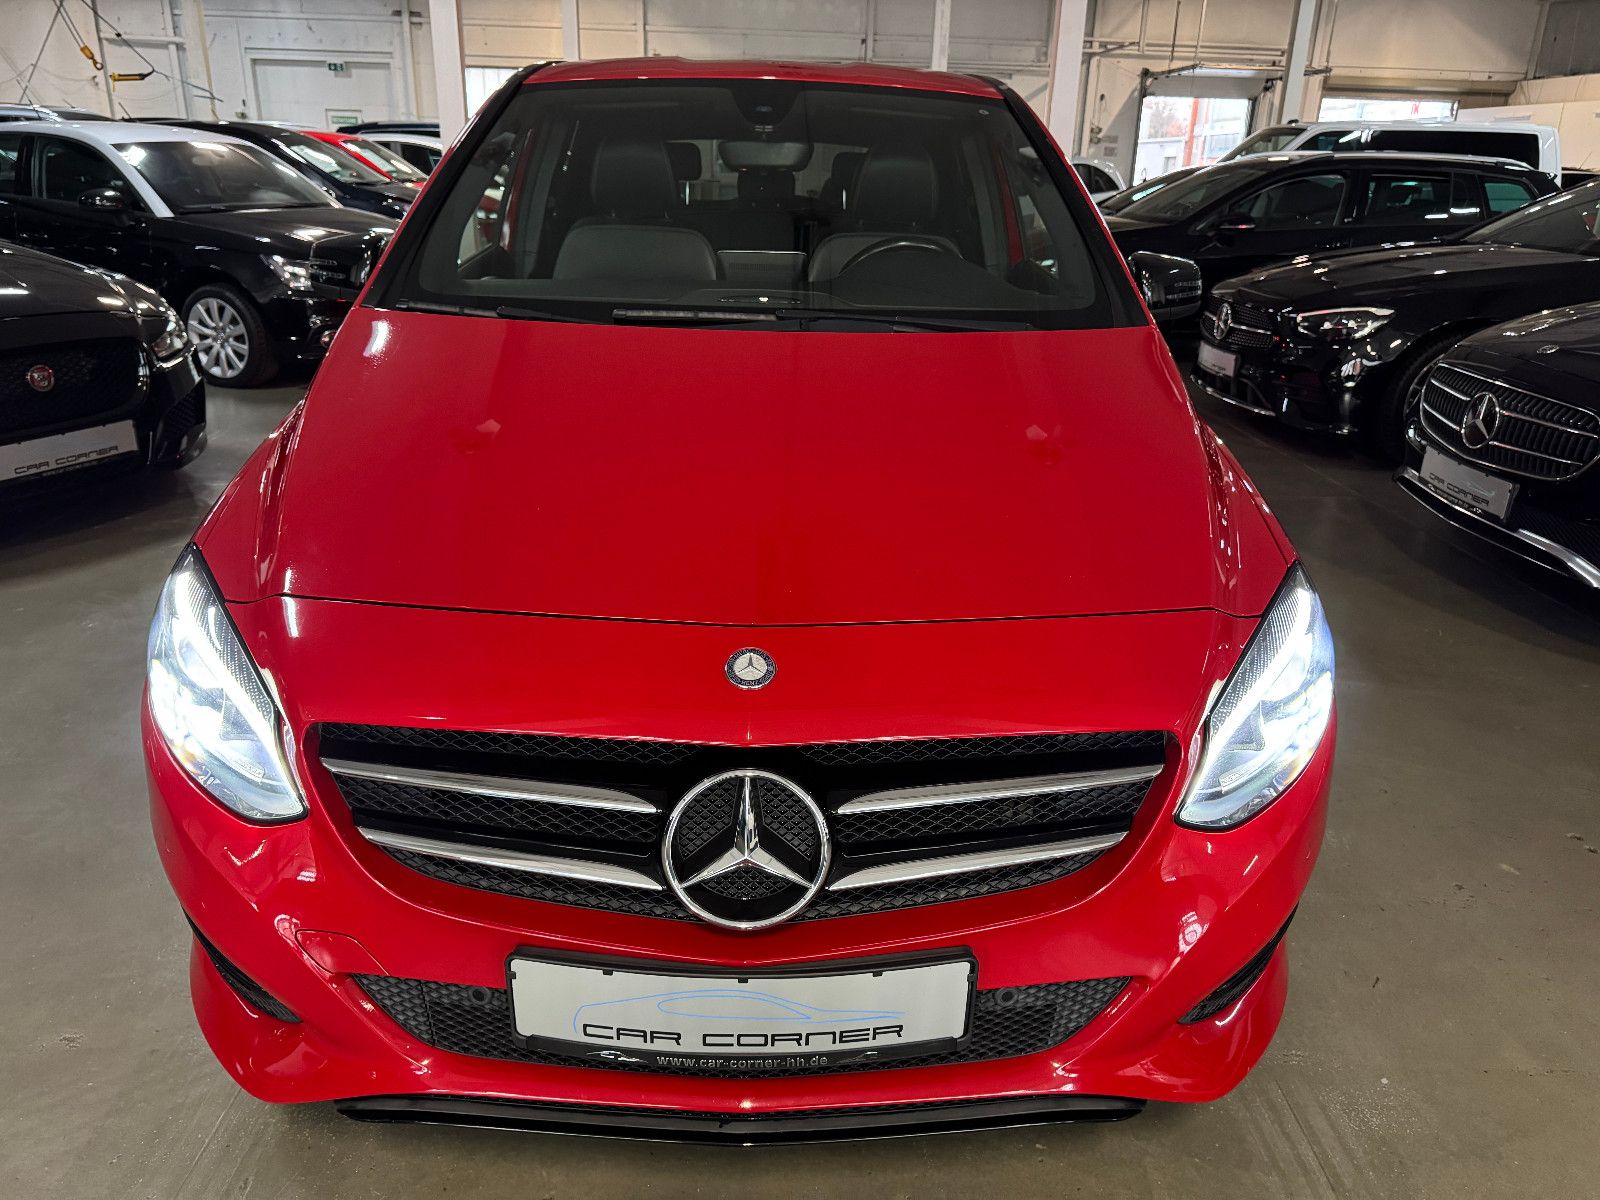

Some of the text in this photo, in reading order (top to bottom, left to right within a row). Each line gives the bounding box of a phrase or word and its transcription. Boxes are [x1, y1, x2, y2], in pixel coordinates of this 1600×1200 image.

[14, 461, 50, 475] CAR
[55, 445, 119, 466] CORNER
[582, 1023, 904, 1047] CAR CORNER
